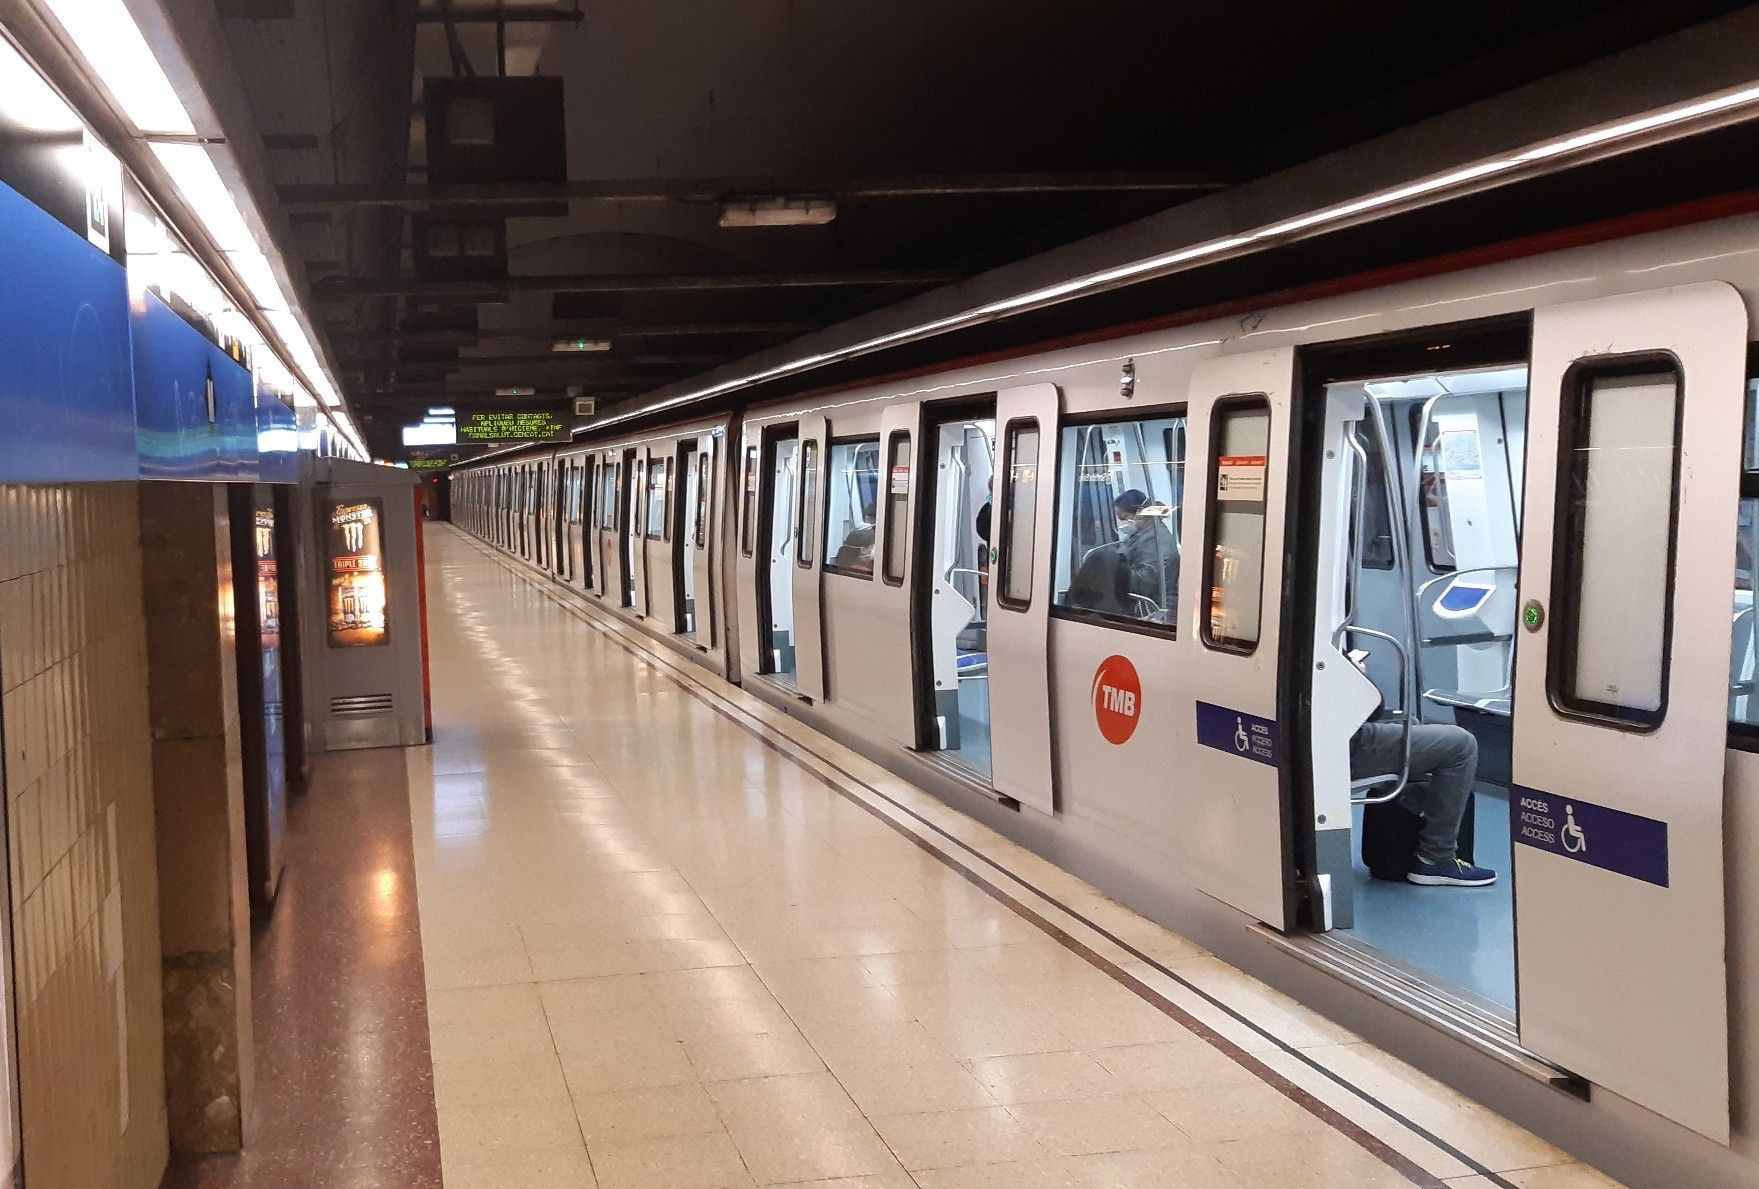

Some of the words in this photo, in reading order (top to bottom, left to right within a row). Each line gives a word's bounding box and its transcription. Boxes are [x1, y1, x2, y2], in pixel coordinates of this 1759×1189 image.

[1102, 685, 1134, 716] TMB
[1520, 811, 1554, 829] ACCESO
[1521, 826, 1554, 843] ACCESS
